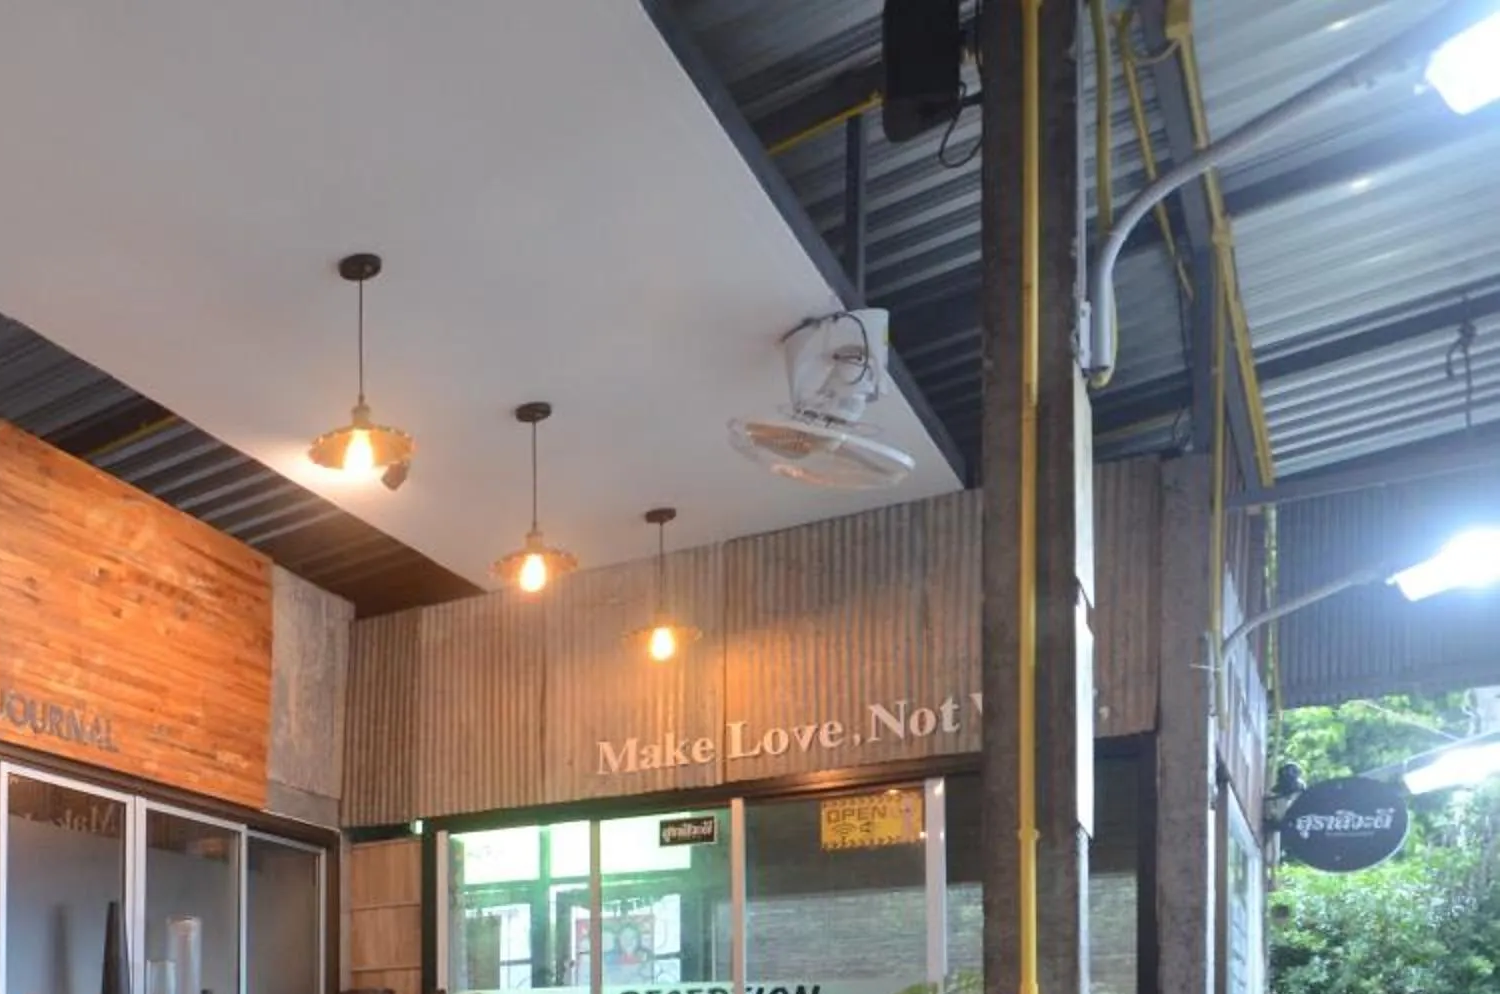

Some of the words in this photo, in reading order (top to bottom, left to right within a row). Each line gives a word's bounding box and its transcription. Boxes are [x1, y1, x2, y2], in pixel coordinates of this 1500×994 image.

[596, 734, 715, 775] Make
[866, 695, 961, 742] Not
[827, 804, 887, 824] OPEN
